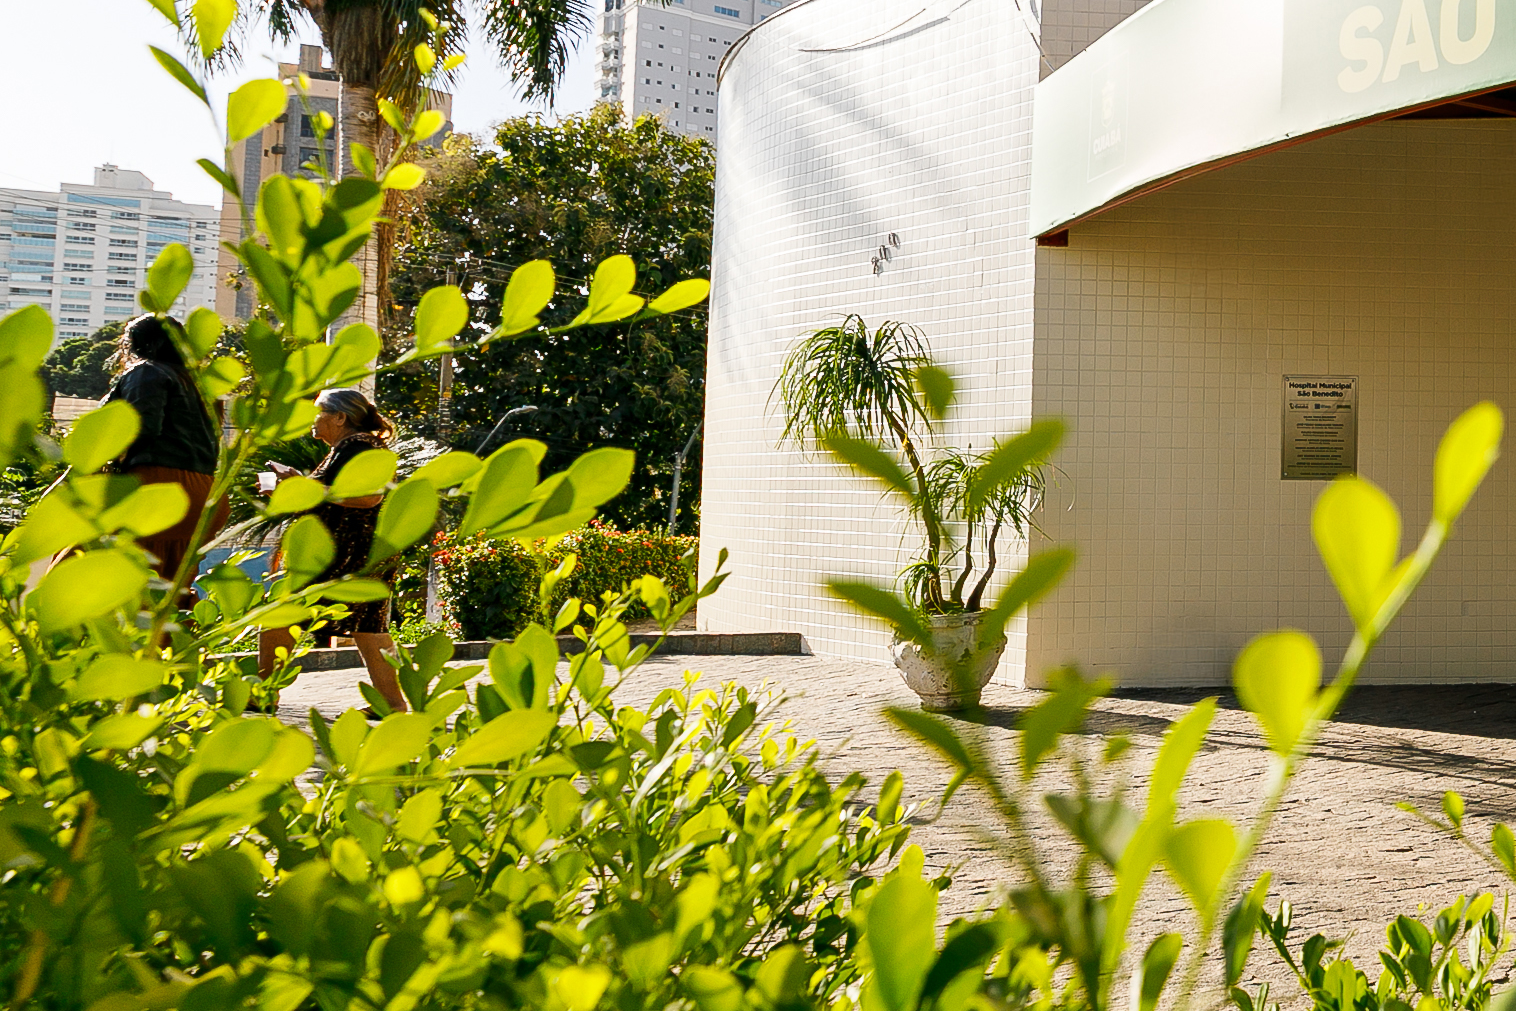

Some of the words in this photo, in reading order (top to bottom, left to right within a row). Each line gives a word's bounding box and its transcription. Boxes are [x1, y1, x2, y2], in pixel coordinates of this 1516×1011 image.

[1092, 122, 1122, 155] CUIABÁ
[1289, 382, 1317, 390] Hospital
[1319, 382, 1352, 391] Municipal
